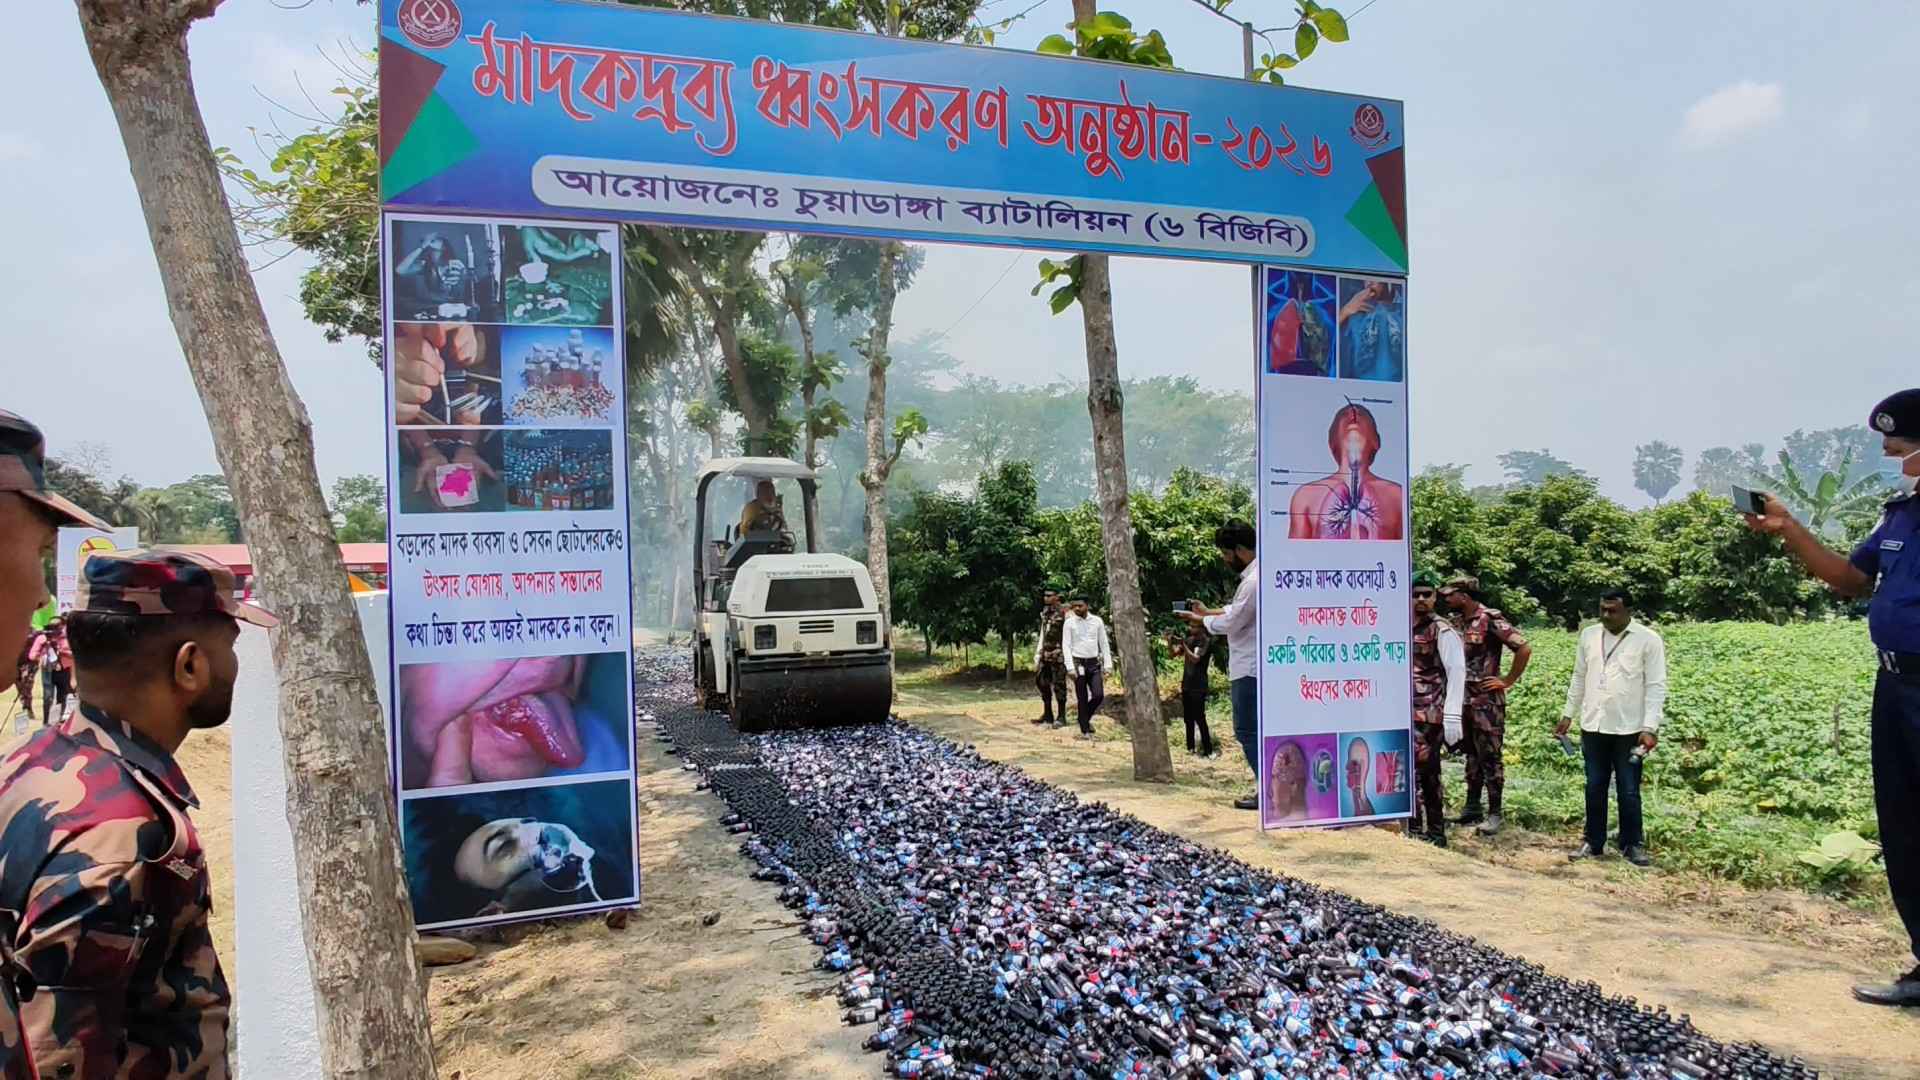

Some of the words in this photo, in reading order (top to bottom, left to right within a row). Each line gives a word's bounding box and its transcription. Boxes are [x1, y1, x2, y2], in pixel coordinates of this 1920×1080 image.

[466, 20, 737, 157] মাদকদ্রব্য
[751, 55, 1009, 152] ধ্বংসকরণ
[1021, 80, 1334, 183] অনুষ্ঠান-২০২৬
[551, 168, 780, 210] আয়োজনেঃ
[793, 185, 946, 222] চুয়াডাঙ্গা
[961, 196, 1133, 233] ব্যাটালিয়ন
[1144, 213, 1185, 243] (৬
[1199, 213, 1309, 253] বিজিবি)
[397, 532, 436, 563] বড়দের
[439, 532, 469, 557] মাদক
[472, 530, 505, 556] ব্যবসা
[509, 531, 519, 554] ও
[523, 530, 552, 555] সেবন
[557, 520, 624, 554] ছোটদেরকেও
[512, 571, 556, 596] আপনার
[560, 569, 603, 593] সন্তানের
[1274, 569, 1312, 590] একজন
[1315, 569, 1343, 590] মাদক
[1346, 562, 1384, 592] ব্যবসায়ী
[1388, 570, 1397, 590] ও
[405, 621, 428, 648] কথা
[432, 612, 457, 646] চিন্তা
[461, 620, 486, 645] করে
[490, 608, 524, 643] আজই
[527, 615, 571, 642] মাদককে
[574, 615, 586, 639] না
[1297, 606, 1346, 627] মাদকাসক্ত
[1267, 636, 1297, 664] একটি
[1300, 636, 1336, 663] পরিবার
[1339, 644, 1349, 663] ও
[1352, 634, 1381, 662] একটি
[1384, 641, 1407, 664] পাড়া
[1299, 674, 1339, 705] ধ্বংসের
